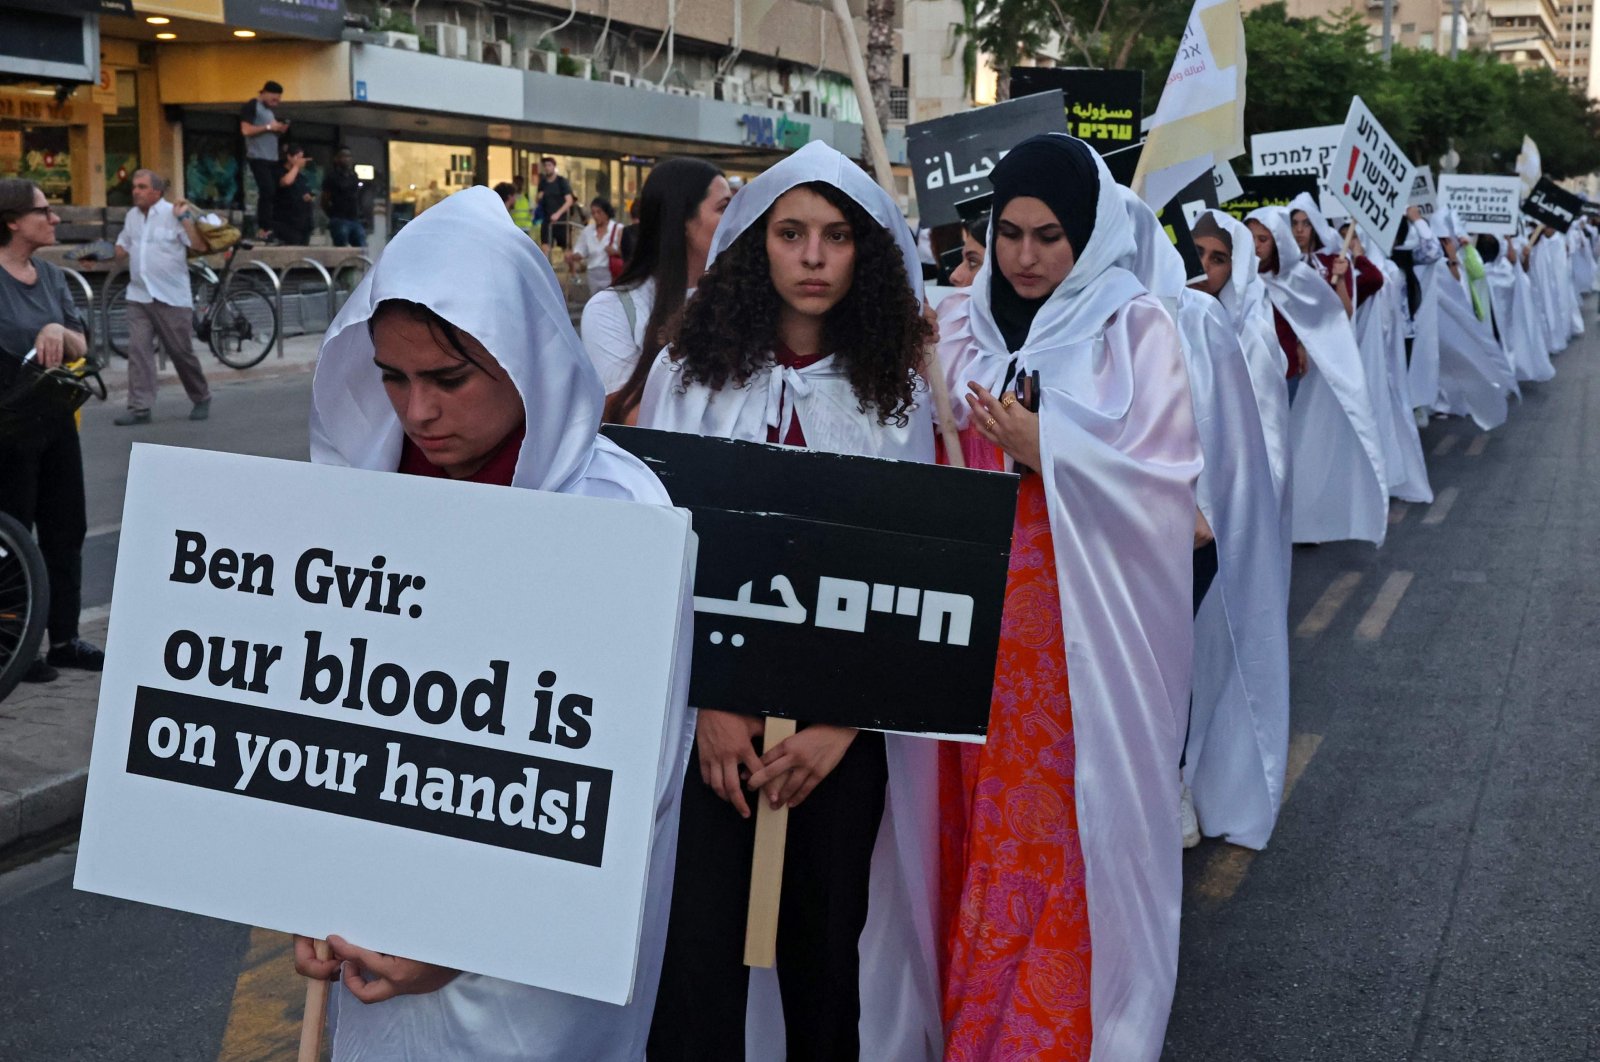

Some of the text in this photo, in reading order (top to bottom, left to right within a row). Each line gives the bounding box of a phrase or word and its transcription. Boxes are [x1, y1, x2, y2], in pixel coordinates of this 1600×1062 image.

[1078, 122, 1132, 140] ערבים
[1261, 146, 1312, 166] למרכז
[1357, 114, 1407, 183] כמה רוע
[1351, 181, 1389, 232] לבלוע
[1362, 152, 1399, 208] אפשר
[1450, 193, 1508, 203] Safeguard
[169, 529, 427, 619] Ben Gvir:
[814, 575, 975, 647] חיים
[163, 628, 594, 751] our blood is
[147, 716, 593, 841] on your hands!
